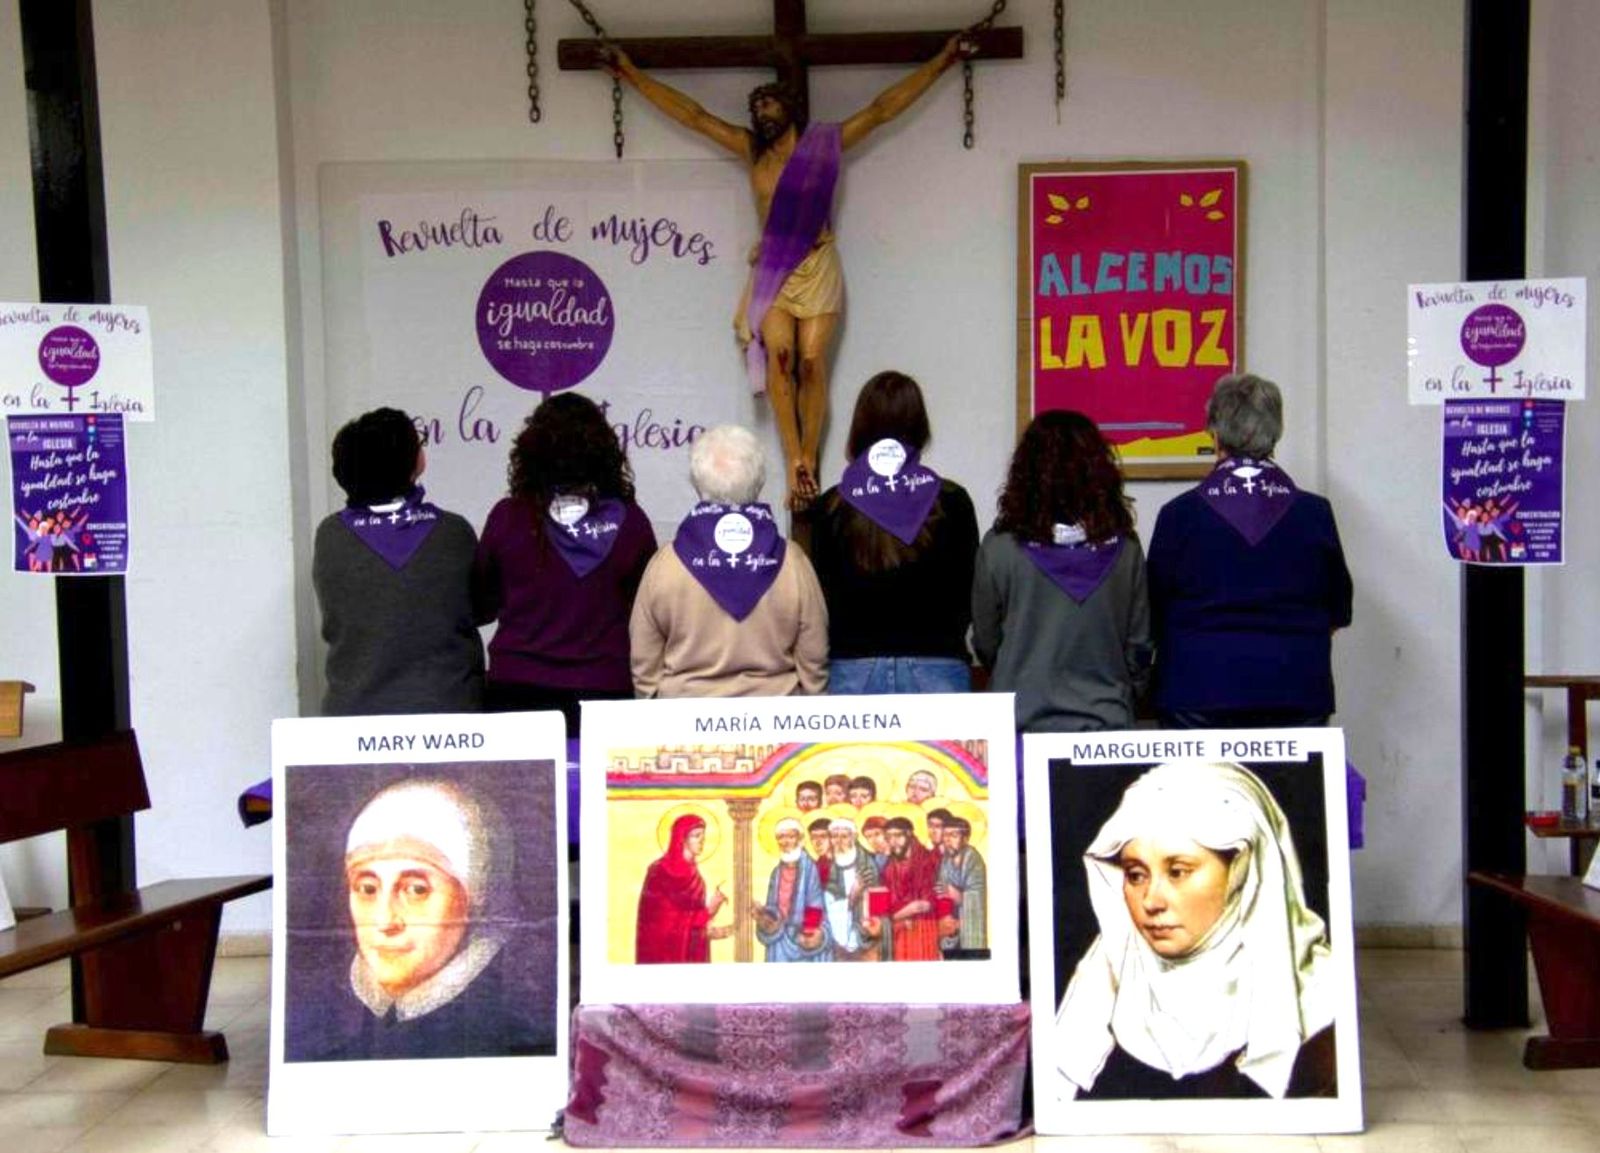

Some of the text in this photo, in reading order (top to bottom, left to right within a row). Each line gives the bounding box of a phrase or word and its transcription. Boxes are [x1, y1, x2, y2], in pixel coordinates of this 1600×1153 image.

[378, 205, 717, 265] Revuelta de mujeres
[504, 278, 541, 288] Hasta
[547, 279, 568, 291] que
[1038, 251, 1233, 297] ALCEMOS
[1488, 284, 1504, 300] de
[1515, 286, 1575, 308] mujeres
[63, 306, 80, 322] de
[487, 288, 609, 337] igualdad
[1040, 308, 1230, 370] LA VOZ
[1464, 322, 1523, 344] igualdad
[497, 340, 511, 349] se
[513, 336, 541, 355] haga
[1425, 378, 1443, 392] en
[1451, 365, 1472, 392] la
[459, 385, 500, 443] la
[1477, 424, 1508, 435] IGLESIA
[1461, 430, 1535, 457] Hasta que la
[30, 445, 100, 469] Hasta que la
[1451, 449, 1552, 485] igualdad se haga
[20, 464, 117, 498] igualdad se haga
[1476, 475, 1533, 498] costumbre
[47, 487, 100, 509] costumbre
[694, 711, 902, 733] MARÍA MAGDALENA
[357, 732, 485, 752] MARY WARD
[1072, 740, 1298, 760] MARGUERITE PORETE
